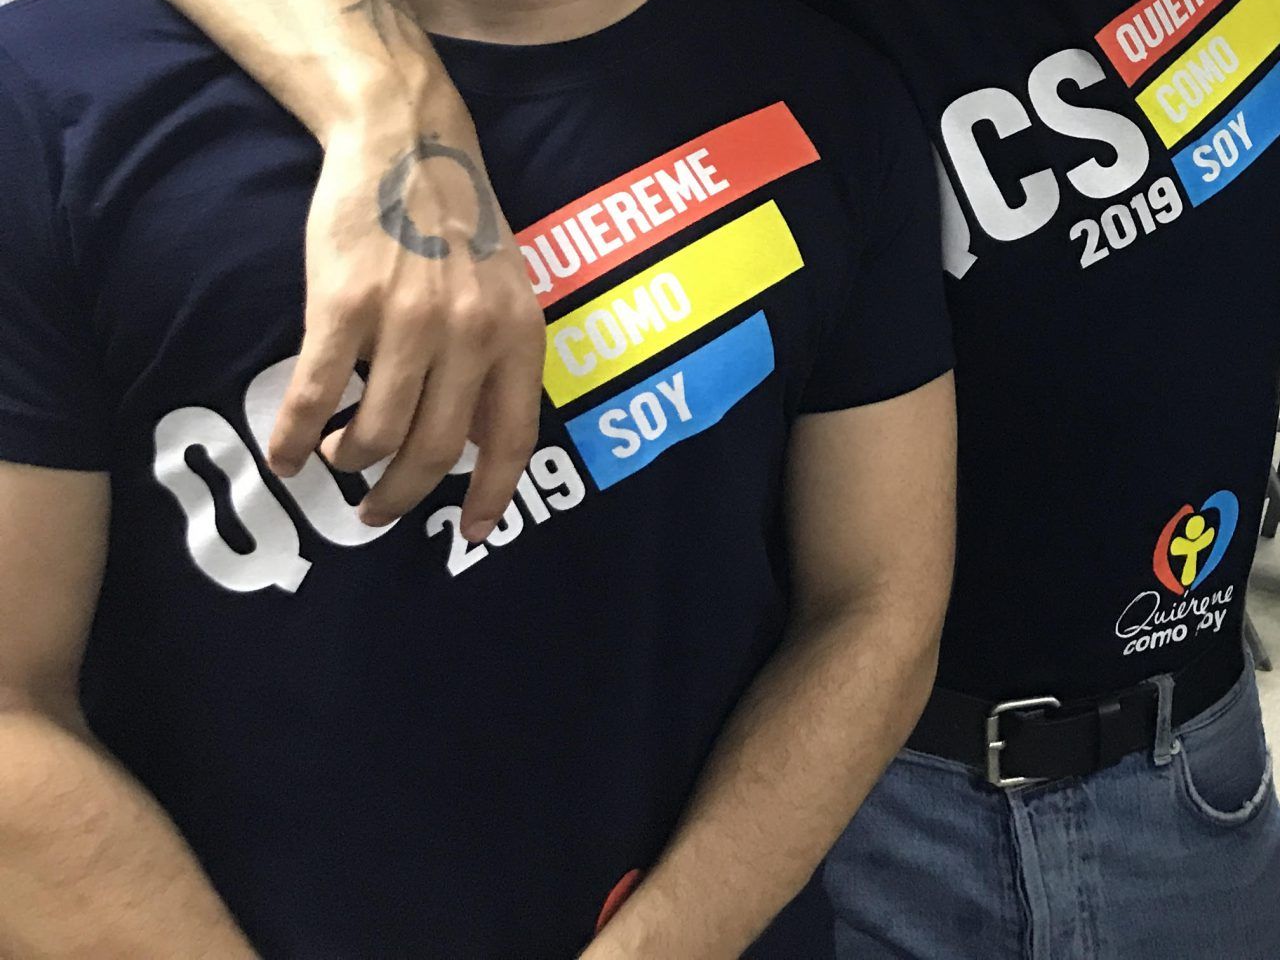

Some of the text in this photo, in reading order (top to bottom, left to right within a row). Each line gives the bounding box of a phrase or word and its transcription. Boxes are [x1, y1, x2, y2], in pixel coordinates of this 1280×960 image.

[1155, 35, 1239, 124] COMO
[1193, 112, 1254, 183] SOY
[1069, 176, 1183, 268] 2019
[553, 272, 691, 378] COMO
[599, 372, 692, 460] SOY
[152, 355, 480, 594] QC
[1123, 608, 1227, 656] como oy
